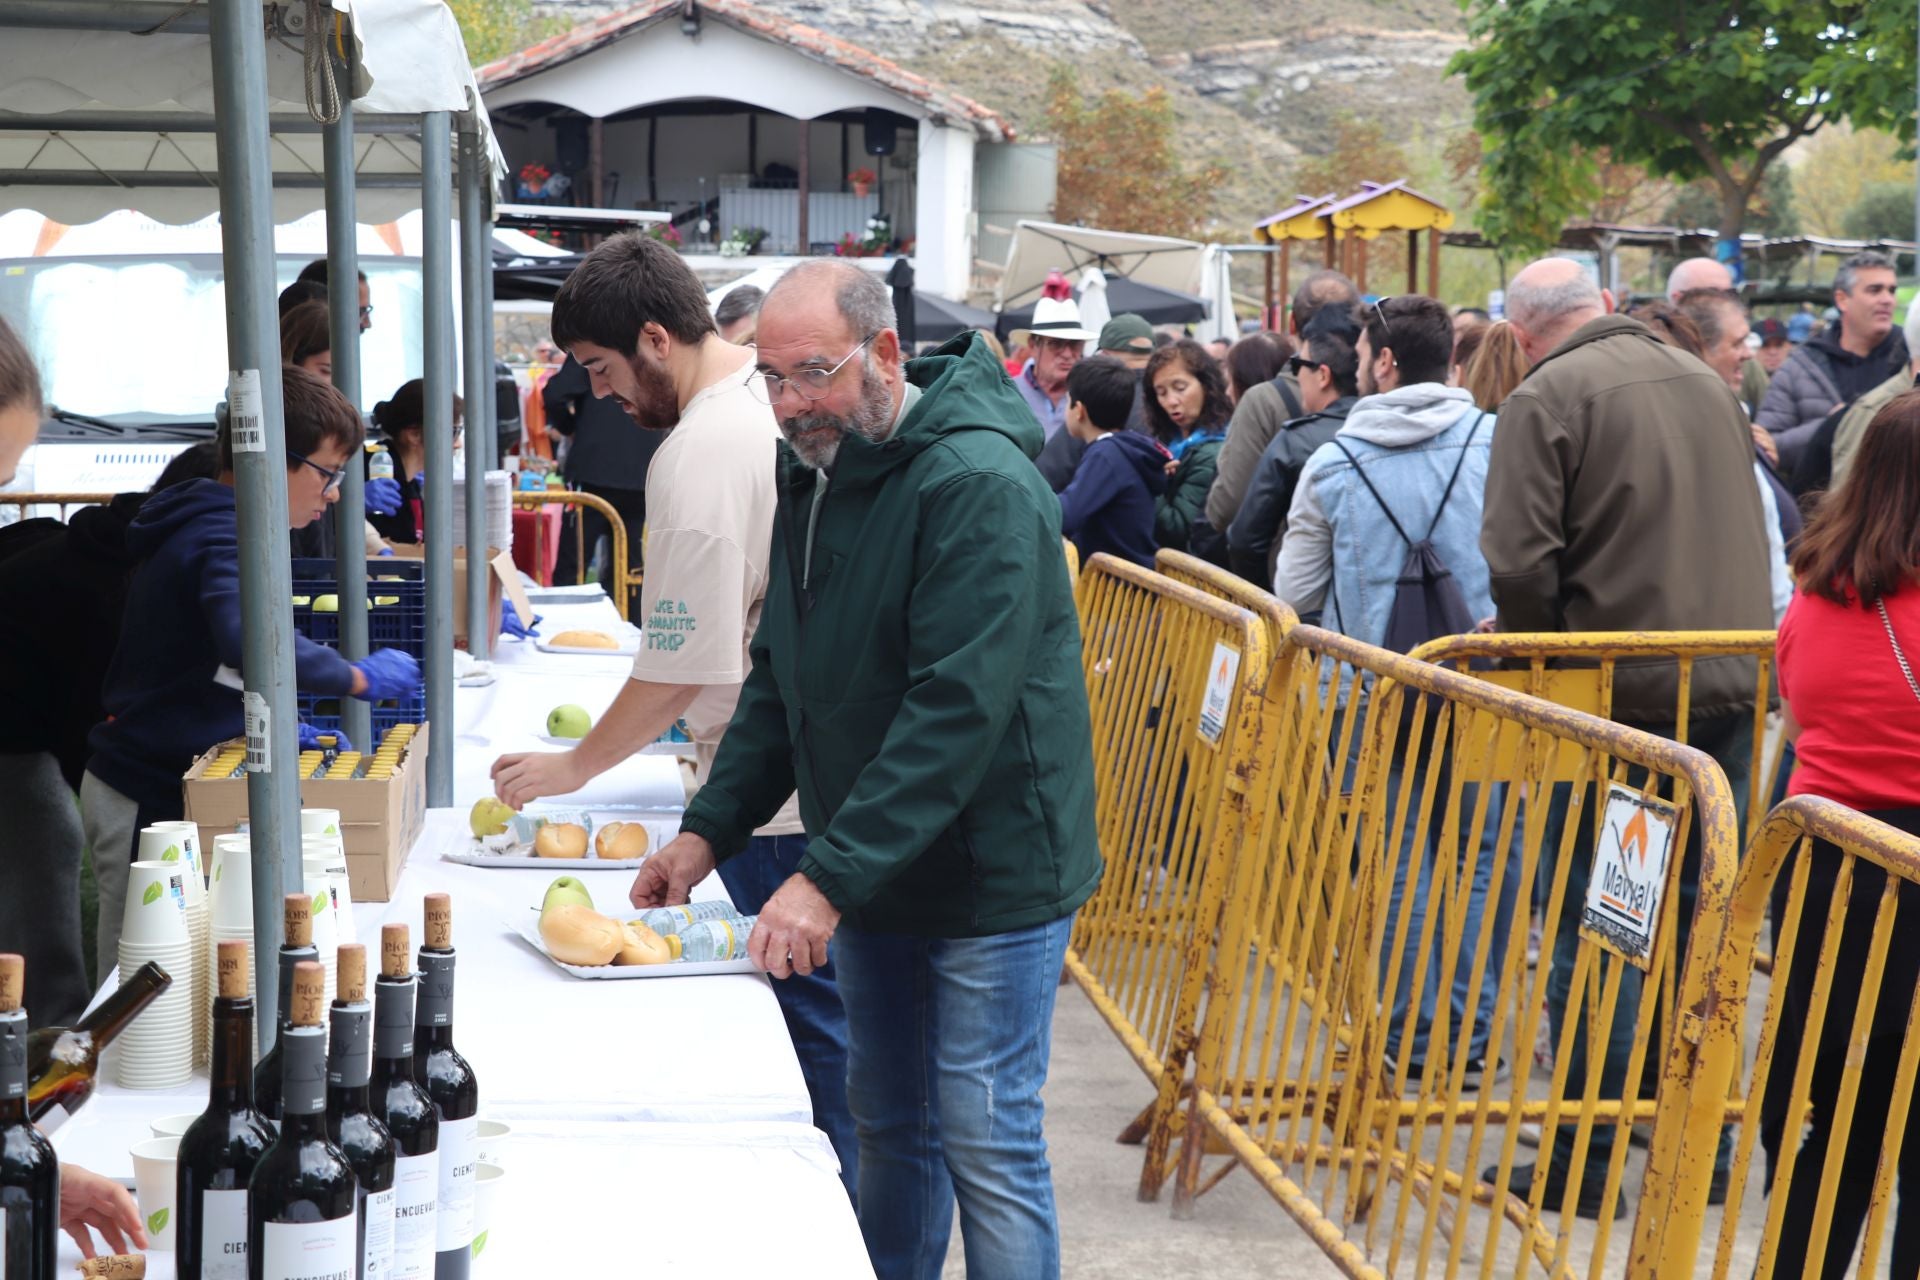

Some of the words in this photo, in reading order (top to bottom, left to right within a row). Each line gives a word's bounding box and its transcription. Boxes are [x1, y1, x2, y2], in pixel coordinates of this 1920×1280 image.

[655, 600, 674, 614] AKE
[678, 601, 688, 614] A
[648, 615, 696, 631] OMANTIC
[648, 632, 685, 651] TRIP
